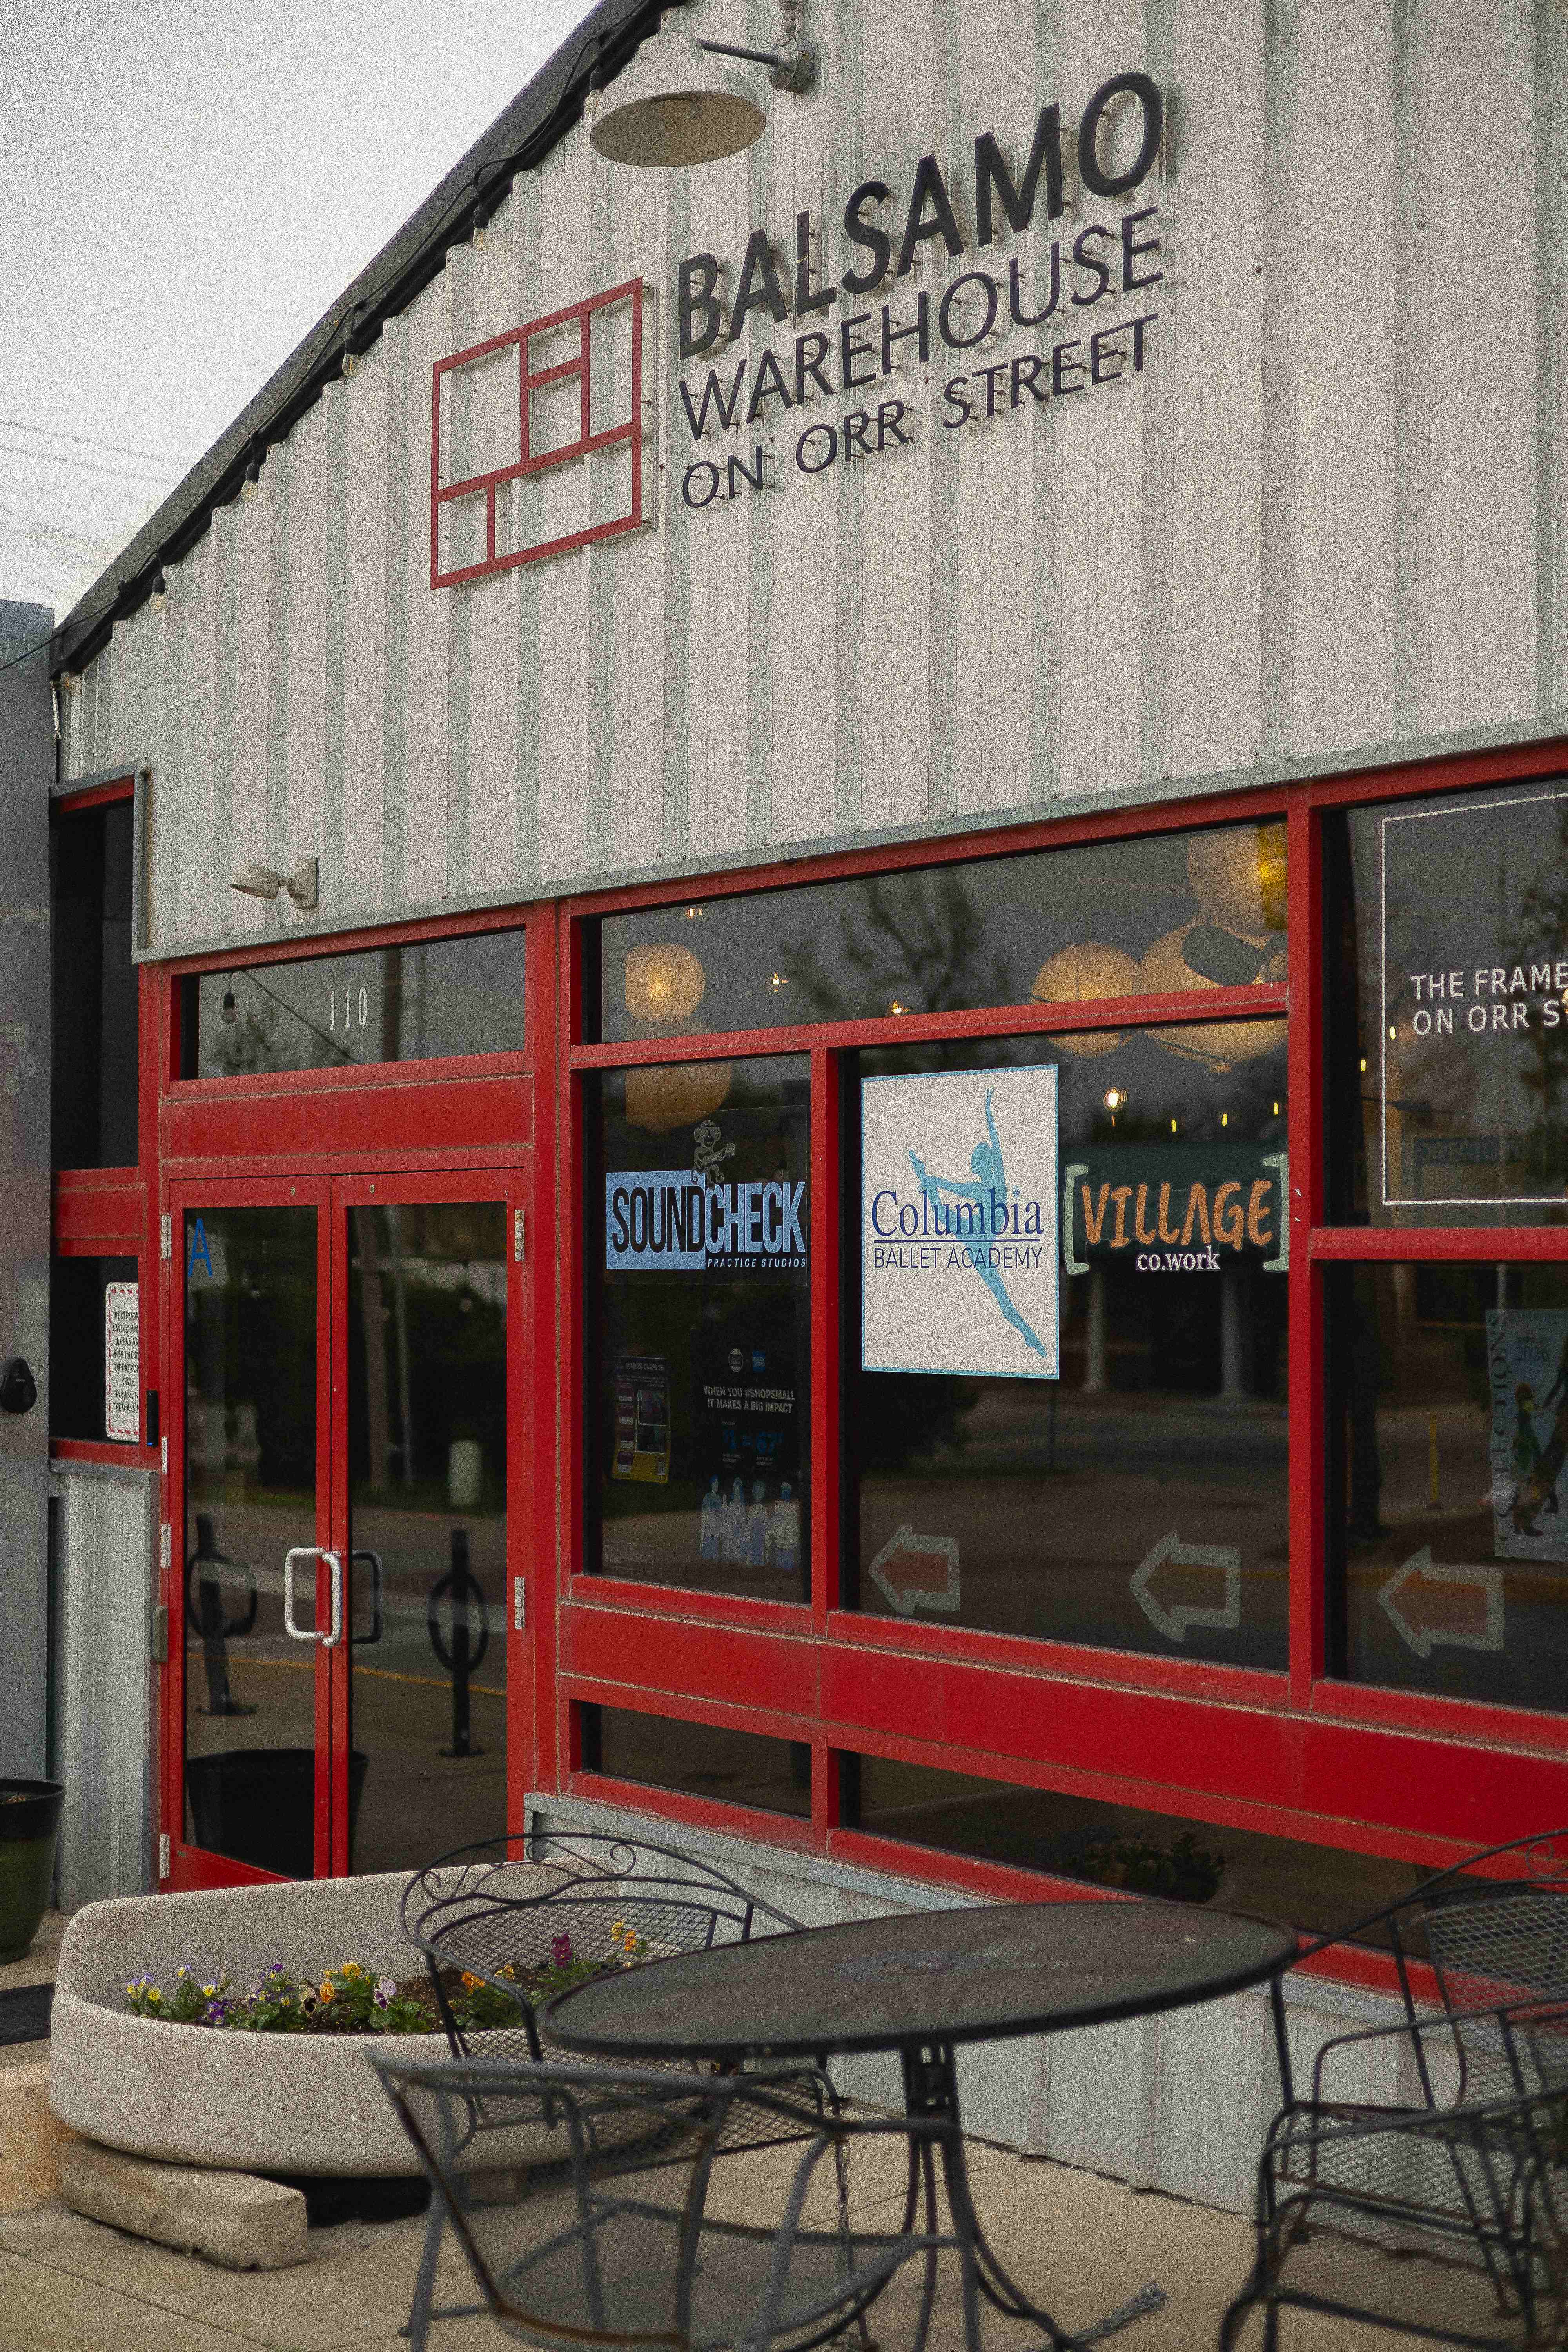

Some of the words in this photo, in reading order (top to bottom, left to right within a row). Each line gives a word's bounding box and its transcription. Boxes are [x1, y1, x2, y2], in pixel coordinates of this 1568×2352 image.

[679, 72, 1163, 360] BALSAMO
[678, 205, 1164, 440] WAREHOUSE
[682, 445, 763, 508] ON
[796, 400, 909, 473] ORR
[943, 313, 1158, 429] STREET
[1411, 972, 1463, 1000] THE
[1475, 962, 1568, 995] FRAME
[330, 987, 367, 1031] 110
[1414, 1009, 1453, 1036] ON
[1468, 1002, 1529, 1031] ORR
[612, 1182, 806, 1253] SOUNDCHECK
[872, 1187, 1044, 1236] Columbia
[1082, 1180, 1273, 1250] VILLAGE
[187, 1218, 212, 1278] A
[708, 1258, 756, 1267] PRACTICE
[761, 1258, 806, 1267] STUDIOS
[875, 1247, 941, 1269] BALLET
[947, 1247, 1043, 1269] ACADEMY
[1137, 1245, 1221, 1270] co.work
[112, 1323, 122, 1332] AND
[116, 1337, 131, 1347] AREAS
[114, 1350, 123, 1359] FOR
[125, 1350, 133, 1360] THE
[114, 1363, 121, 1372] OF
[703, 1385, 725, 1396] WHEN
[727, 1387, 742, 1397] YOU
[745, 1388, 795, 1401] #SHOPSMALL
[708, 1398, 714, 1408] IT
[717, 1399, 742, 1410] MAKES
[744, 1400, 749, 1410] A
[751, 1401, 763, 1411] BIG
[766, 1402, 792, 1414] IMPACT
